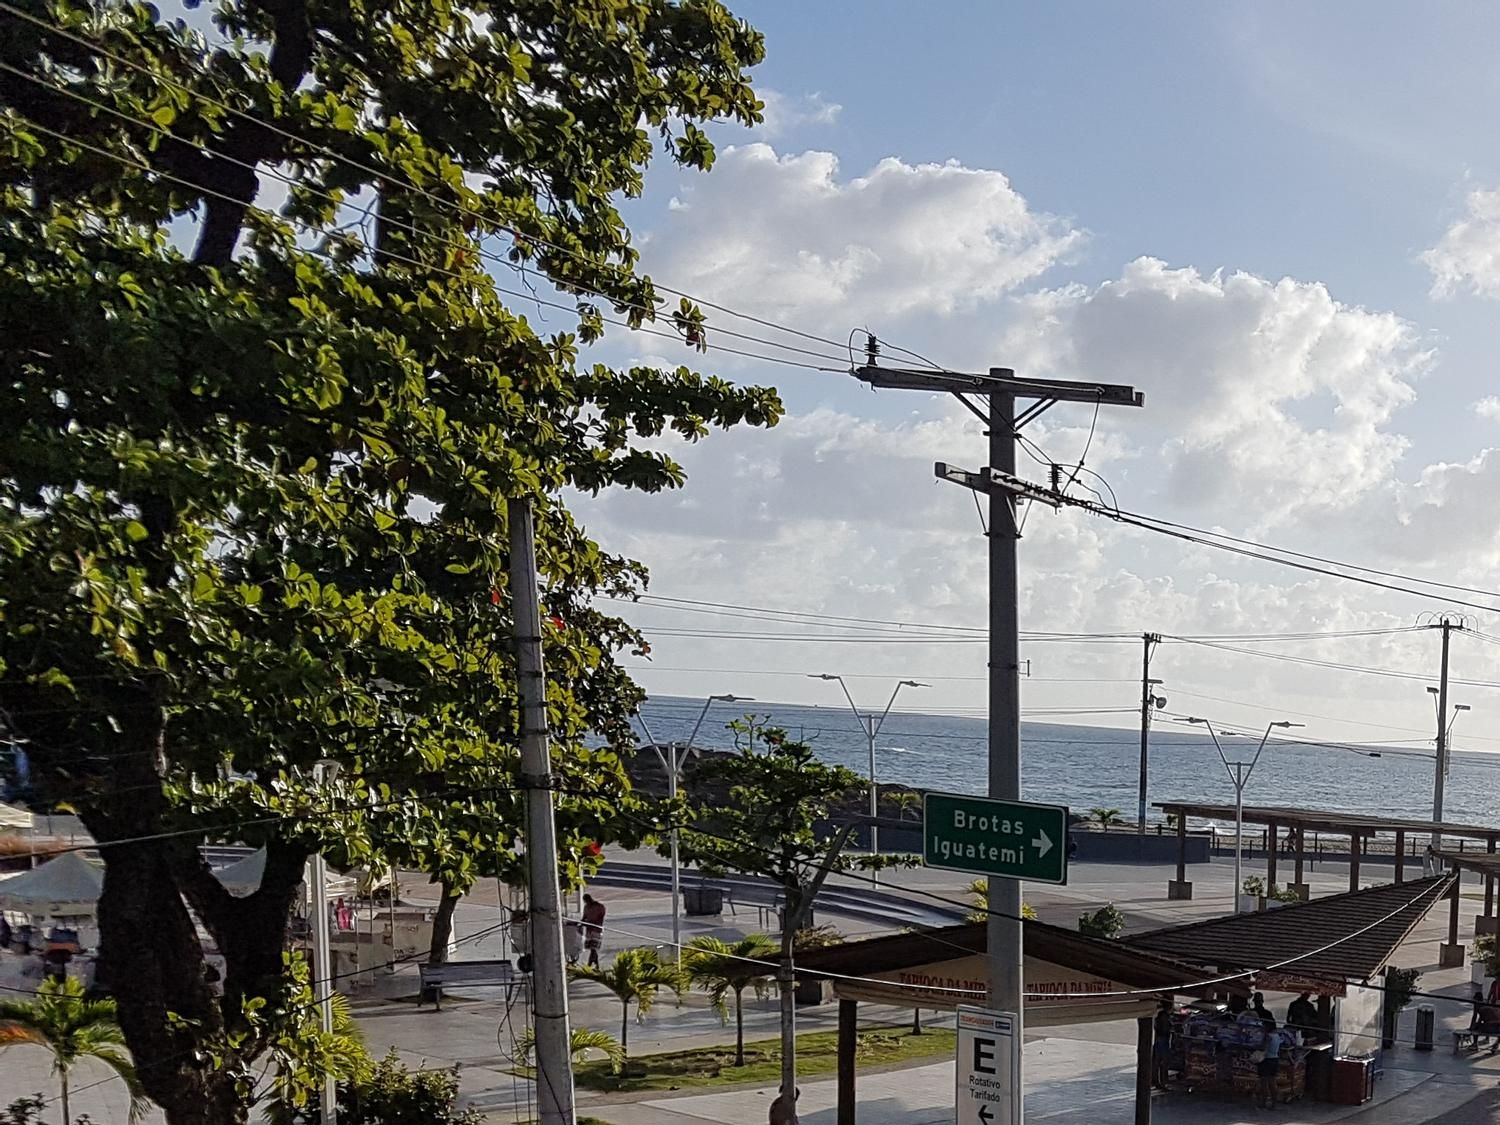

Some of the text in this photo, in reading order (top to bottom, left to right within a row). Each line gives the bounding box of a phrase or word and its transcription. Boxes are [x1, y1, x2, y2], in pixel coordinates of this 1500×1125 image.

[954, 809, 1024, 835] Brotas
[934, 836, 1024, 864] Iguatemi
[973, 1037, 996, 1075] E
[969, 1075, 1001, 1090] Rotativo
[969, 1088, 1001, 1103] Tarifado
